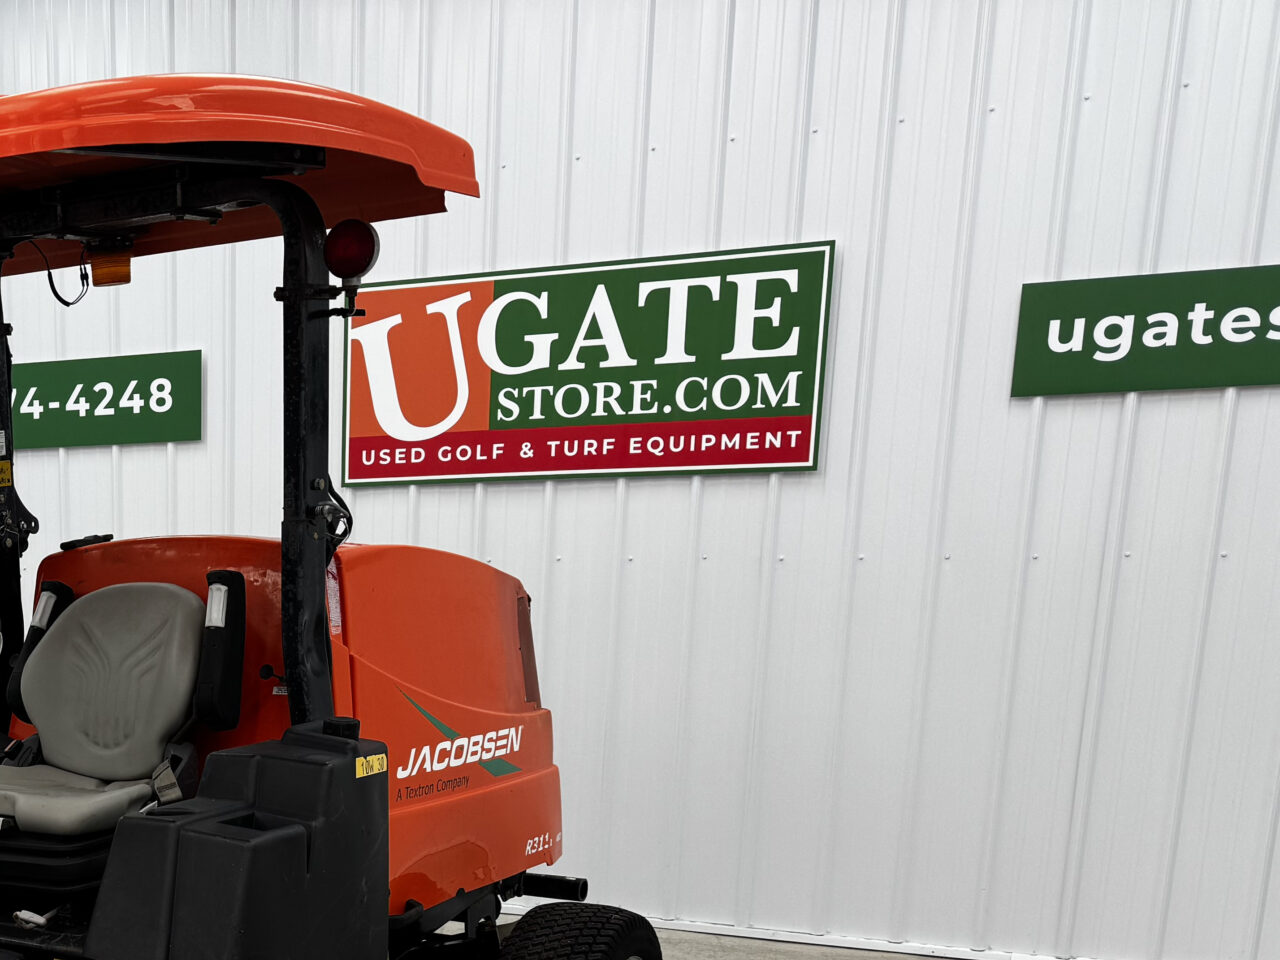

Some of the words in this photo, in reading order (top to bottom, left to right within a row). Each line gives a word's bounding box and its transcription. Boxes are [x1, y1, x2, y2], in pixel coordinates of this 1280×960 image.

[496, 370, 803, 422] STORE.COM
[361, 447, 426, 466] USED
[437, 443, 506, 463] GOLF
[519, 442, 535, 459] &
[548, 437, 617, 457] TURF
[628, 430, 803, 456] EQUIPMENT
[396, 725, 522, 779] JACOBSEN
[396, 788, 402, 802] A
[405, 783, 434, 800] Textron
[436, 775, 470, 793] Company
